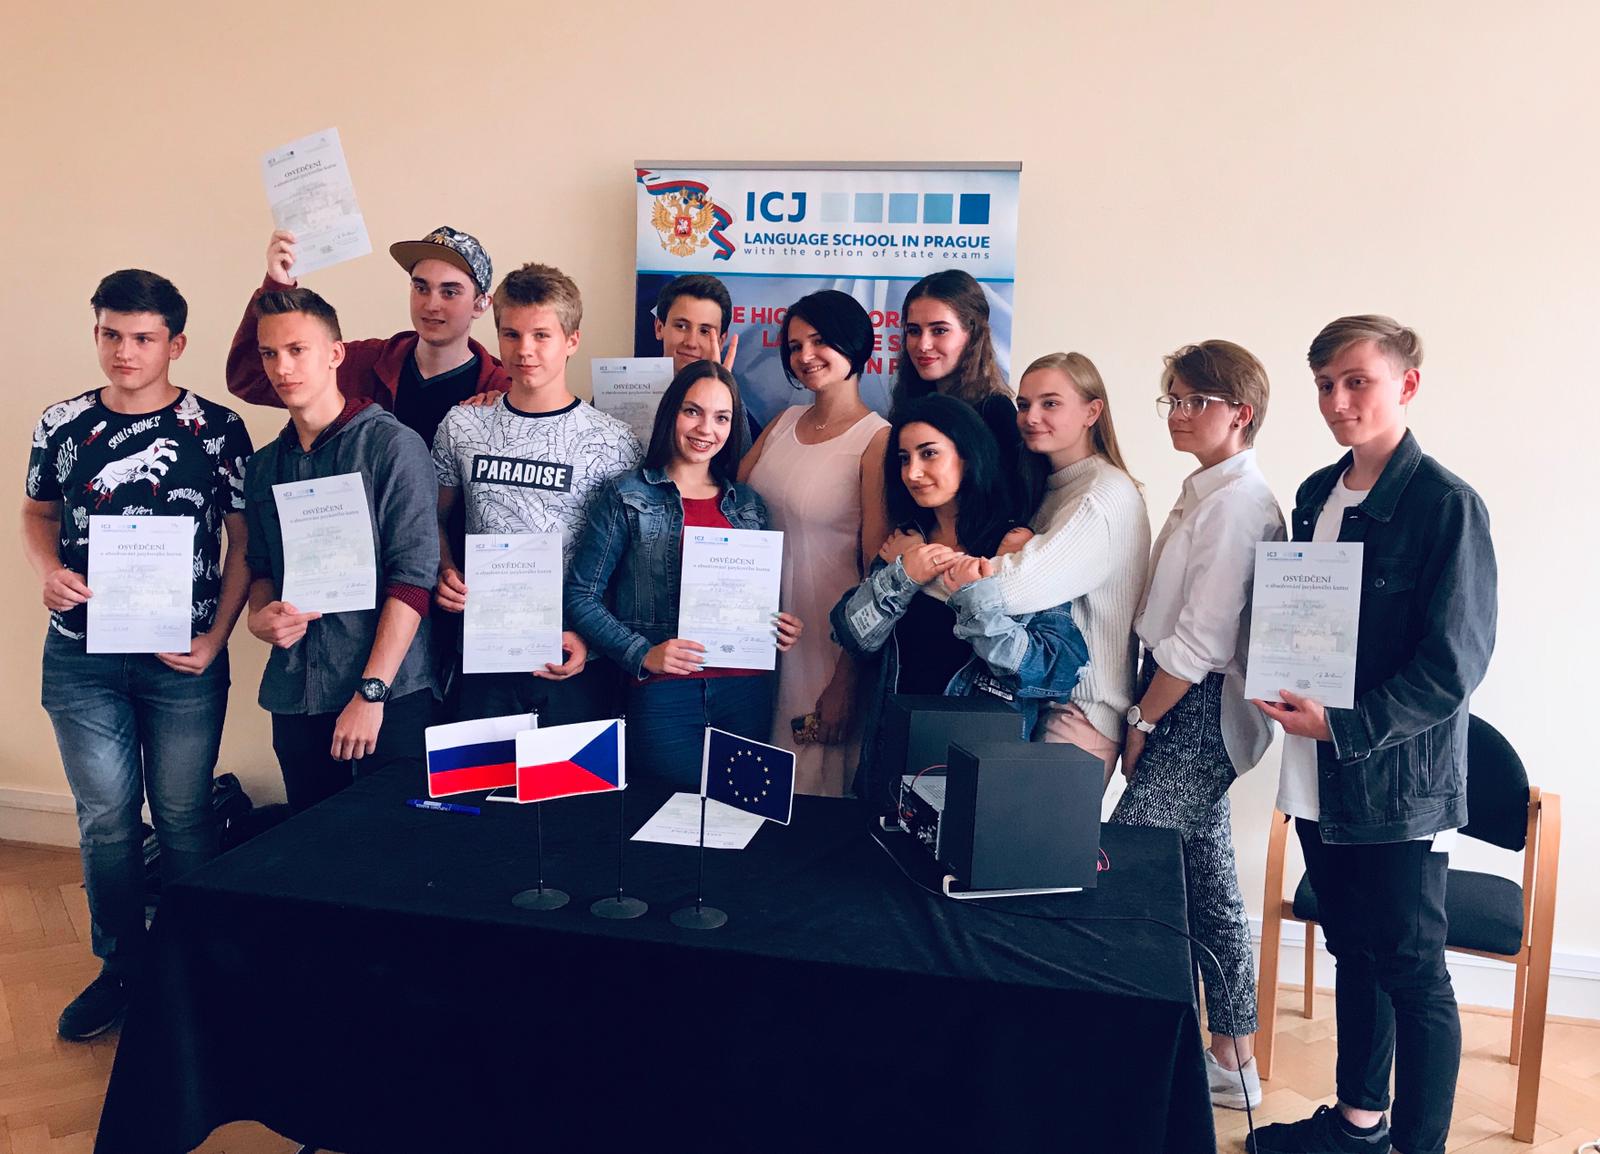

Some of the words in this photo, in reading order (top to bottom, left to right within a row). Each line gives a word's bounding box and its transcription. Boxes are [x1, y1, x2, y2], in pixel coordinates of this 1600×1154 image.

[746, 191, 807, 222] ICJ
[744, 232, 829, 246] LANGUAGE
[832, 233, 898, 247] SCHOOL
[902, 235, 919, 247] IN
[923, 235, 990, 249] PRAGUE
[744, 247, 775, 255] with
[783, 247, 806, 256] the
[815, 248, 863, 258] option
[872, 249, 886, 258] of
[894, 250, 934, 258] state
[943, 251, 990, 259] exams
[476, 458, 567, 488] PARADISE
